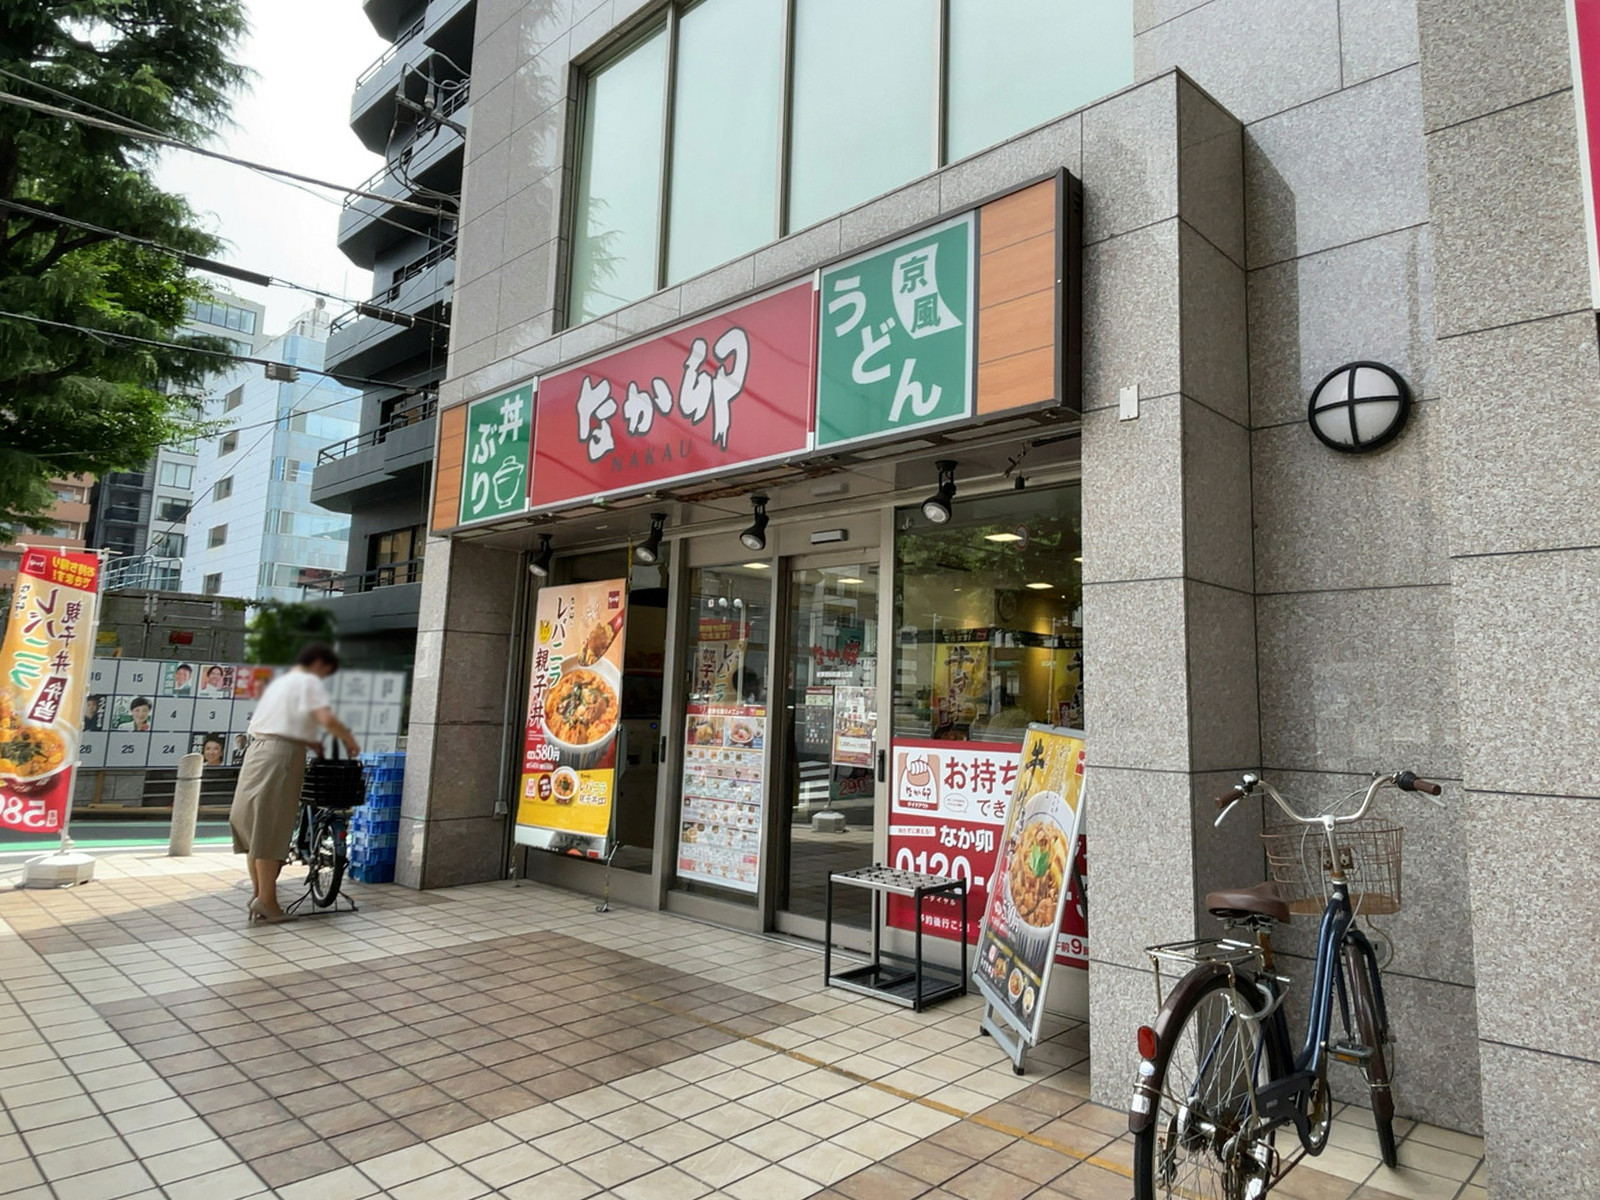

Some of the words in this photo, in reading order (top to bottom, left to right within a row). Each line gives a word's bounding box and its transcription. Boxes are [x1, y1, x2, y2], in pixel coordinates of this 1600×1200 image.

[899, 254, 941, 333] 京風
[828, 275, 943, 422] うどん
[577, 326, 749, 463] なか卯
[611, 440, 693, 472] NAKAU
[549, 597, 569, 687] レバニラ
[90, 672, 102, 681] 16
[132, 673, 144, 683] 15
[529, 648, 549, 727] 親子丼
[170, 710, 177, 719] 4
[209, 711, 216, 720] 3
[79, 744, 92, 754] 26
[121, 744, 135, 754] 25
[162, 745, 175, 755] 24
[905, 786, 932, 800] なか卯
[977, 799, 1006, 819] でき
[940, 825, 994, 853] なか卯
[896, 847, 993, 894] 0120-
